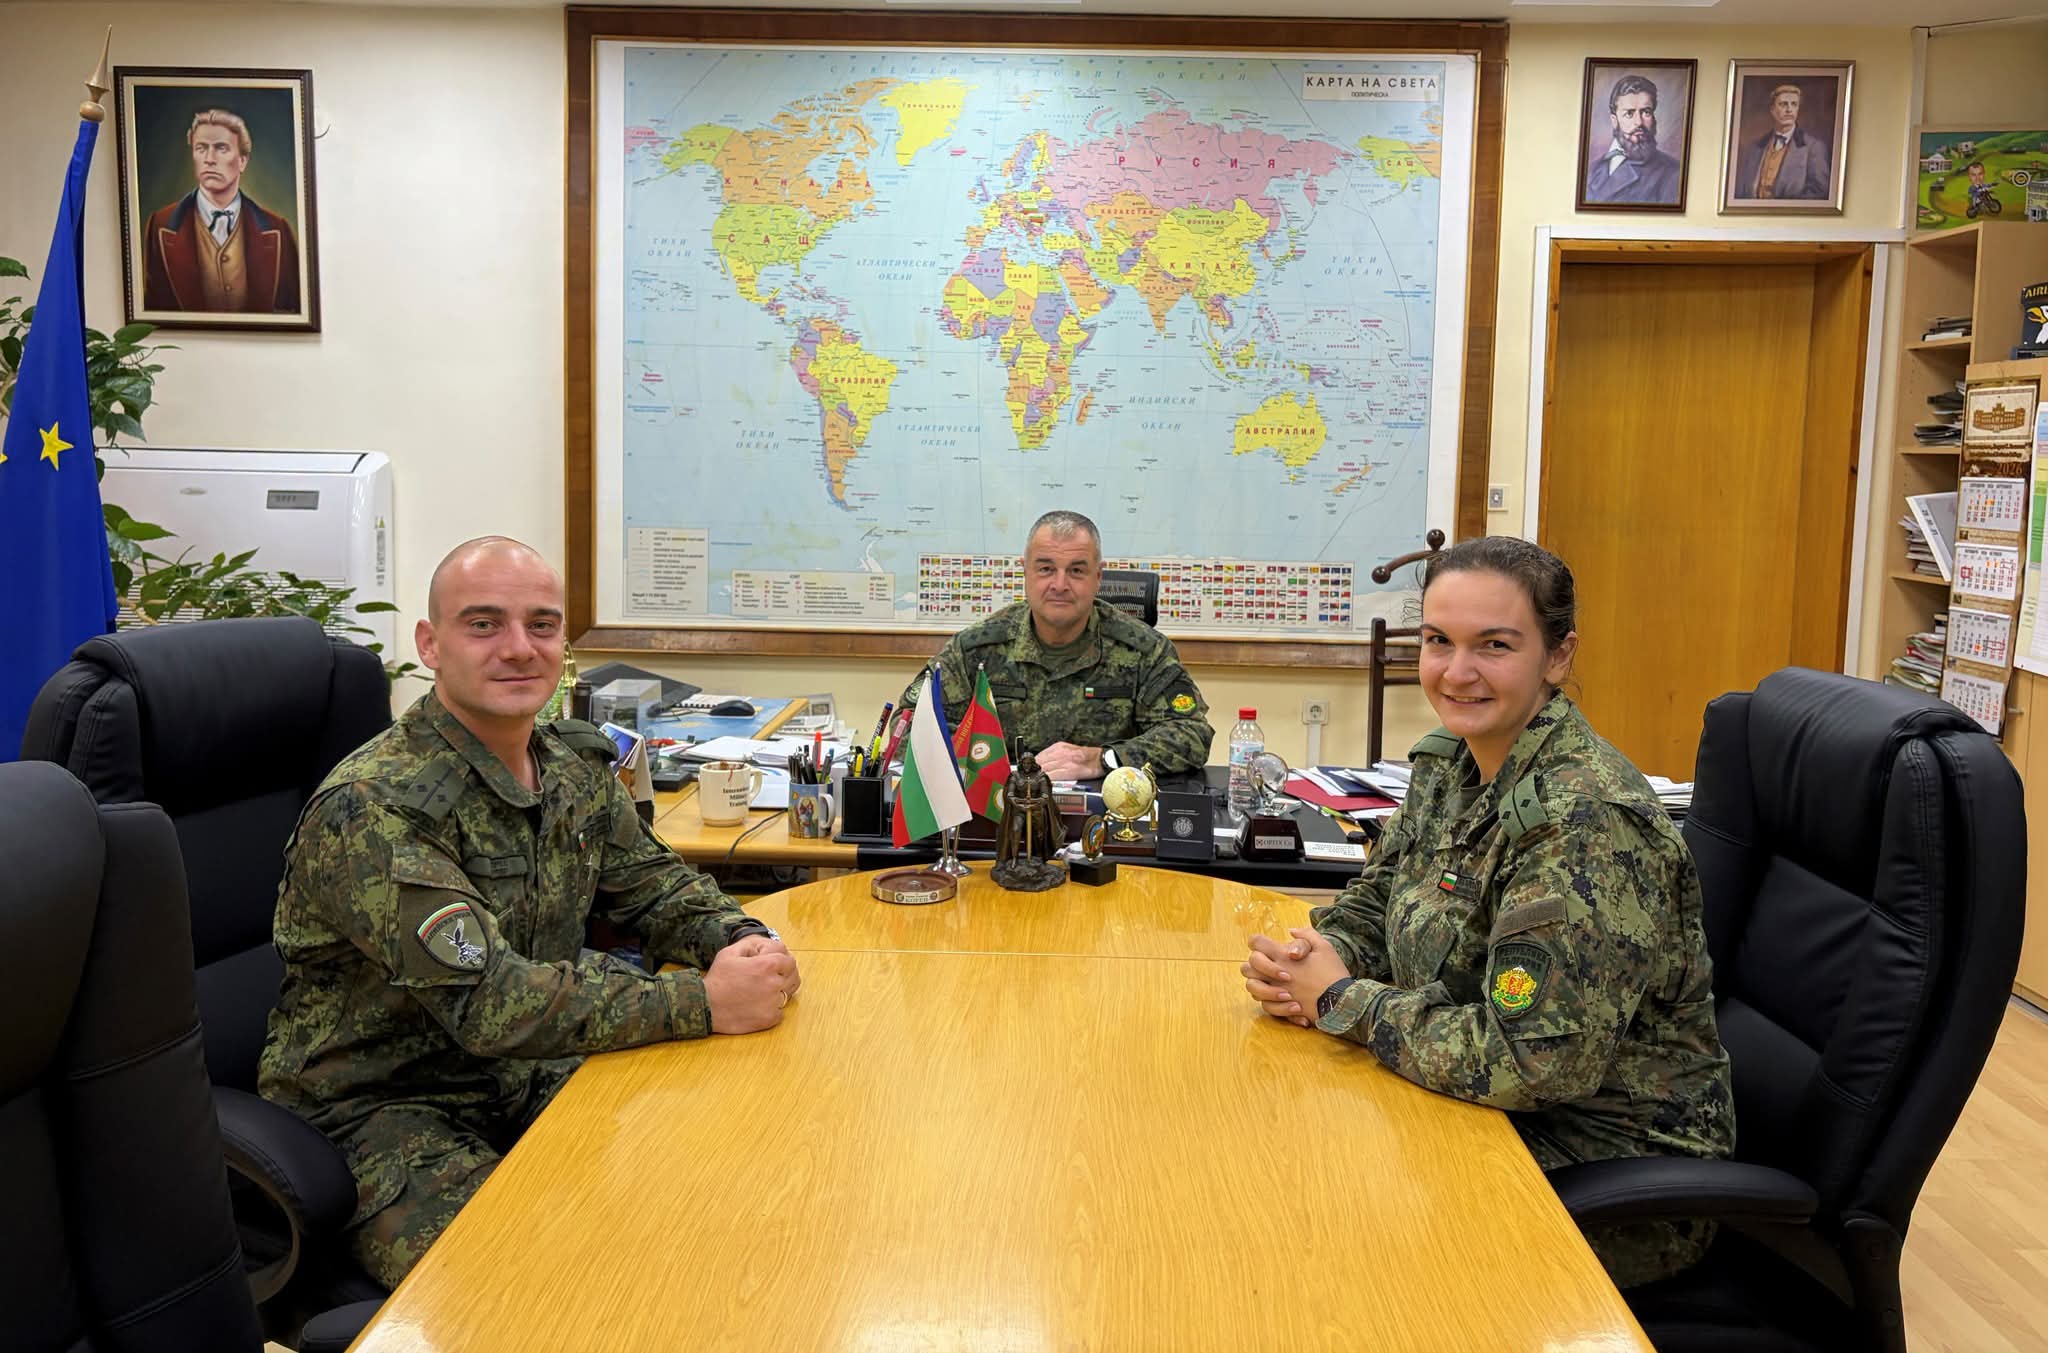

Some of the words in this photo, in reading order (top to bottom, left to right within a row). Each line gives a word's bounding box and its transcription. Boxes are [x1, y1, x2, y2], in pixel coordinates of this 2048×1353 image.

[1306, 76, 1354, 88] КАРТА
[1361, 77, 1381, 88] НА
[1388, 78, 1436, 89] СВЕТА
[1117, 155, 1277, 170] РУСИЯ
[1386, 159, 1414, 167] САЩ
[724, 177, 870, 189] КАНАДА
[727, 233, 809, 246] САЩ
[856, 259, 936, 268] АТЛАНТИЧЕСКИ
[1330, 255, 1377, 264] ТИХИ
[1169, 261, 1239, 270] КИТАЙ
[1323, 267, 1384, 276] ОКЕАН
[878, 272, 913, 281] ОКЕАН
[833, 376, 887, 385] БРАЗИЛИЯ
[897, 424, 982, 433] АТЛАНТИЧЕСКИ
[1244, 427, 1317, 436] АВСТРАЛИЯ
[920, 439, 958, 447] ОКЕАН
[1999, 462, 2023, 475] 2026
